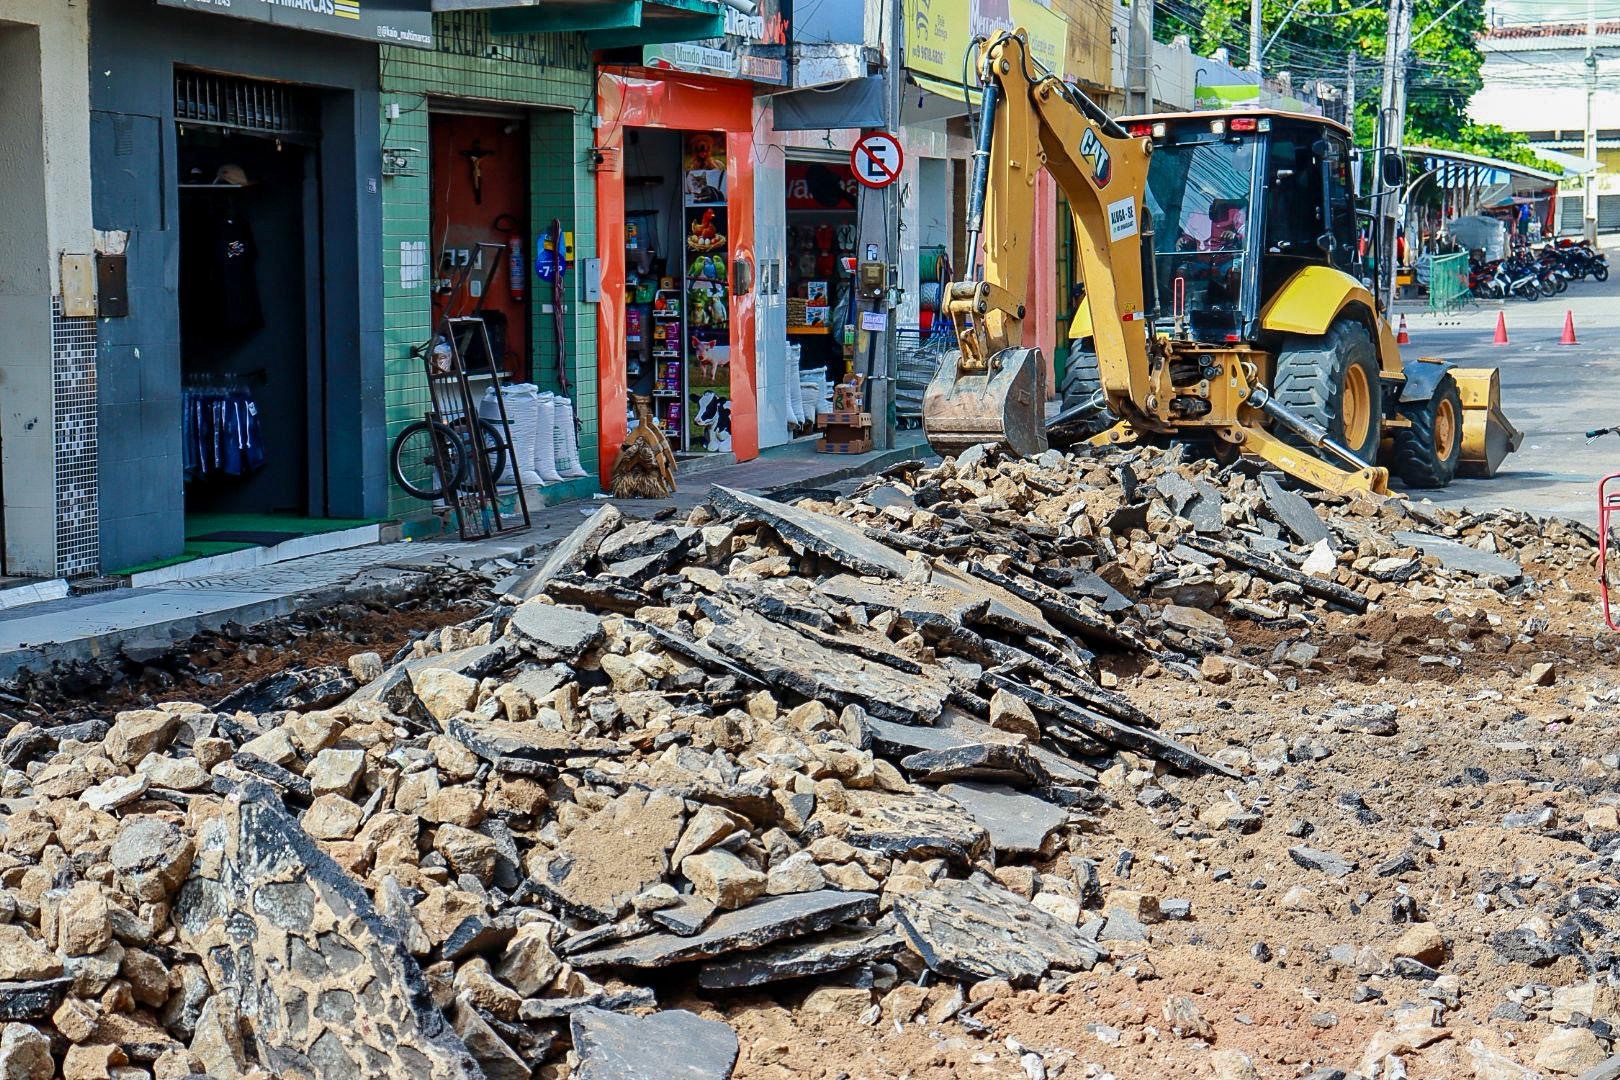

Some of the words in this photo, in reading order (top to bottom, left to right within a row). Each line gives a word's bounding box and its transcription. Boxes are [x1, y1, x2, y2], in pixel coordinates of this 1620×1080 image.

[676, 46, 700, 65] Mundo
[701, 50, 725, 70] Animal
[867, 145, 887, 177] E
[1081, 128, 1109, 176] CAT
